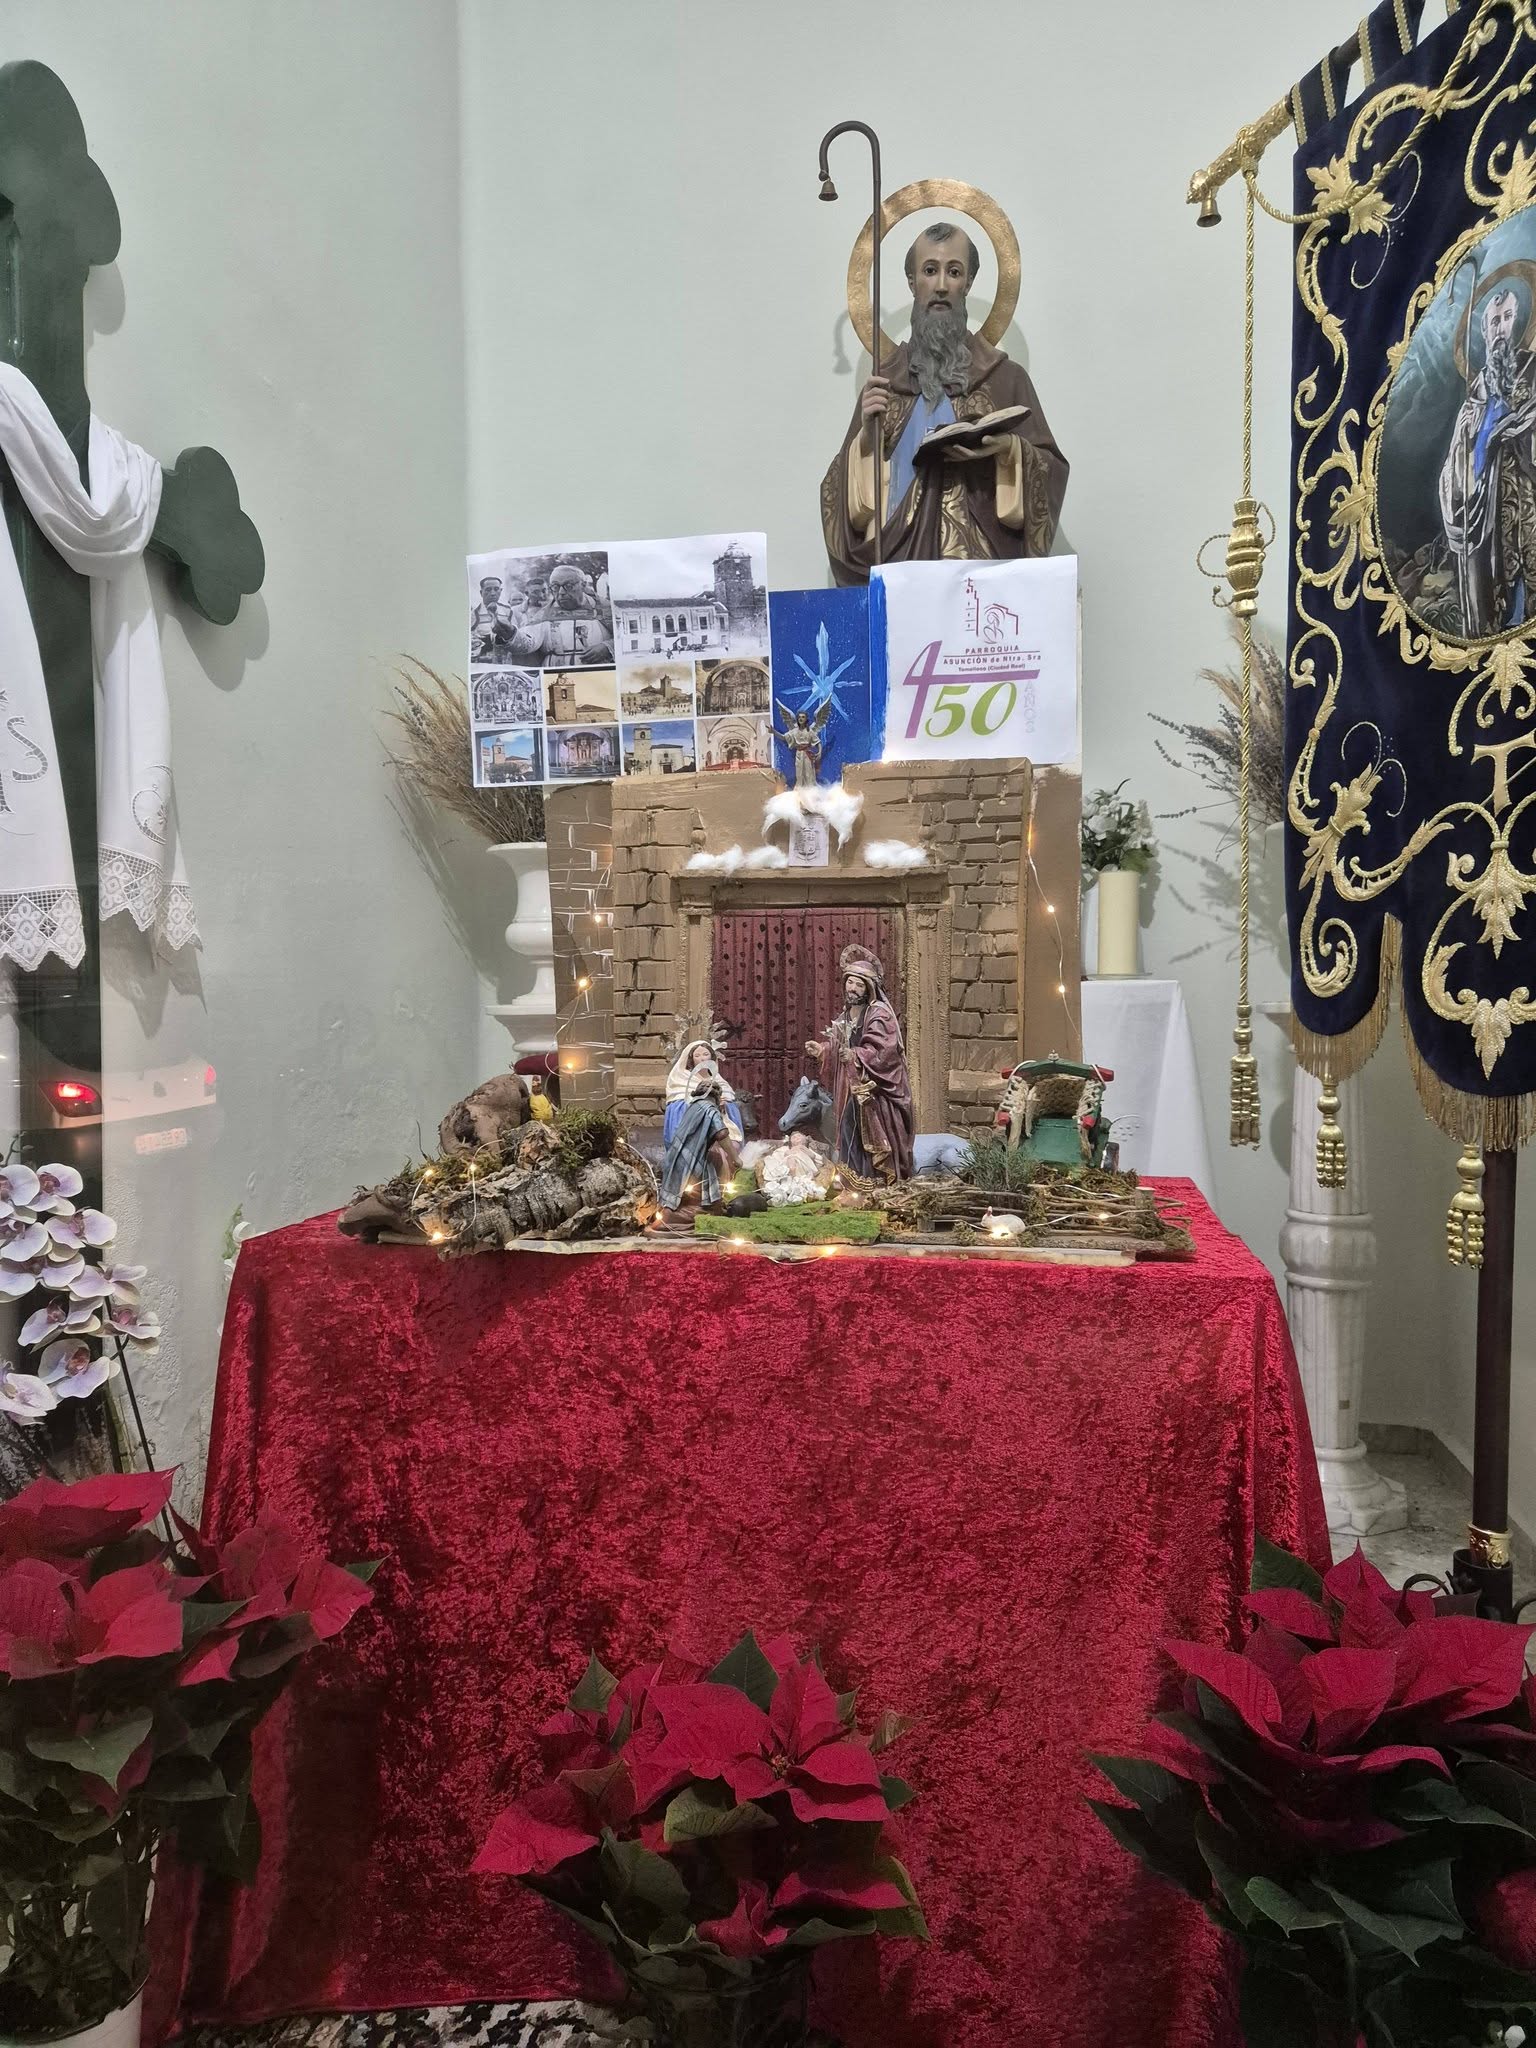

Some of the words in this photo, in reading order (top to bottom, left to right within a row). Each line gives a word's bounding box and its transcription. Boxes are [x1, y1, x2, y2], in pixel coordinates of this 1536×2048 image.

[965, 645, 1019, 654] PARROQUIA
[943, 656, 988, 665] ASUNCIÓN
[903, 640, 1040, 739] 450
